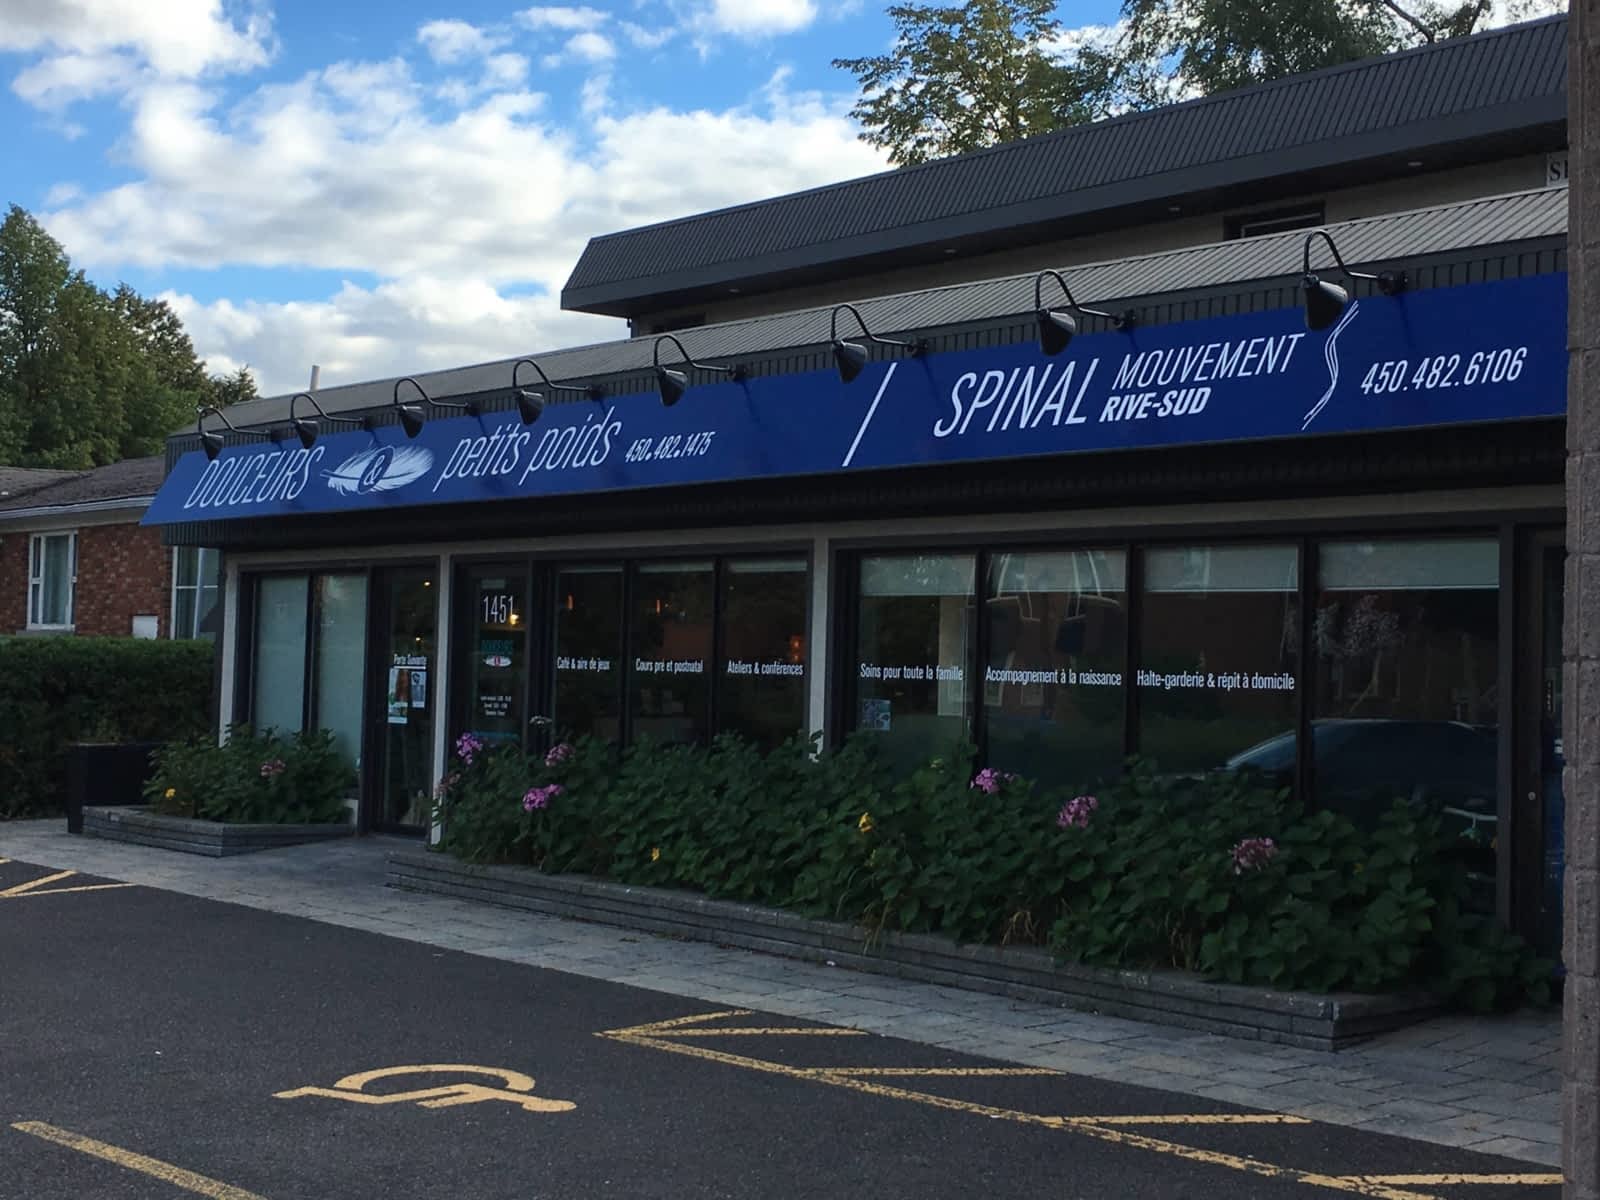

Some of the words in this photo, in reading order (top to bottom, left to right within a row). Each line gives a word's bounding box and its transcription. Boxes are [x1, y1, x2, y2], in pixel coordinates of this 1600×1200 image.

[1360, 347, 1528, 395] 450.482.6106
[934, 358, 1100, 438] SPINAL
[1111, 333, 1306, 391] MOUVEMENT
[1099, 387, 1212, 423] RIVE-SUD
[184, 445, 325, 509] DOUCEURS
[433, 423, 530, 492] petits
[518, 406, 622, 486] poids
[625, 431, 716, 463] 450.482.1475
[483, 595, 514, 624] 1451
[557, 656, 570, 669] Café
[571, 658, 576, 669] &
[589, 657, 597, 670] de
[635, 657, 653, 671] Cours
[654, 658, 665, 674] pré
[666, 659, 673, 672] et
[727, 659, 752, 674] Ateliers
[754, 661, 760, 674] &
[761, 661, 803, 676] conférences
[860, 663, 881, 678] Soins
[883, 667, 901, 680] pour
[903, 664, 924, 680] toute
[926, 665, 933, 680] la
[936, 665, 963, 681] famille
[985, 666, 1058, 685] Accompagnement
[1061, 668, 1066, 684] à
[1068, 668, 1076, 684] la
[1079, 669, 1121, 686] naissance
[1137, 669, 1204, 690] Halte-garderie
[1207, 673, 1215, 688] &
[1218, 671, 1240, 691] répit
[1243, 672, 1249, 688] à
[1251, 672, 1295, 690] domicile
